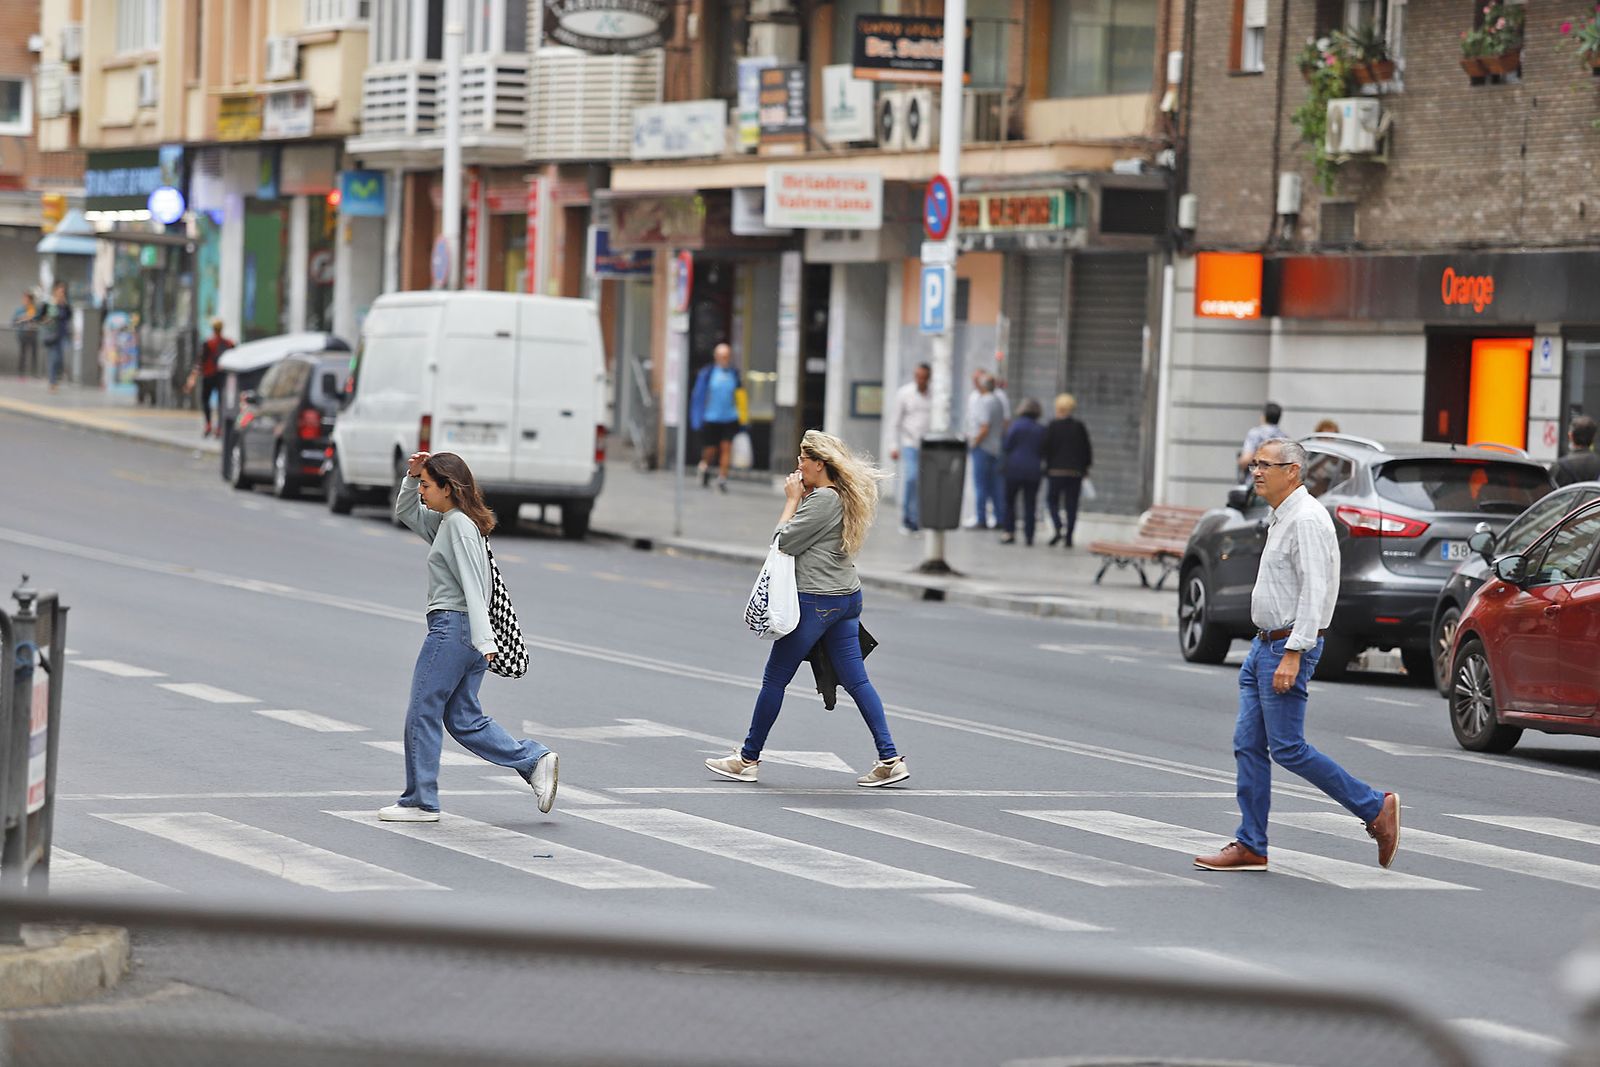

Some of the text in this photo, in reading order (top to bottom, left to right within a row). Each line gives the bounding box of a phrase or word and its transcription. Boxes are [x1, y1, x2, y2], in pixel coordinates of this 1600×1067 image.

[925, 272, 942, 326] P
[1442, 266, 1494, 313] Orange
[1201, 299, 1255, 318] orange
[1451, 543, 1470, 558] 38
